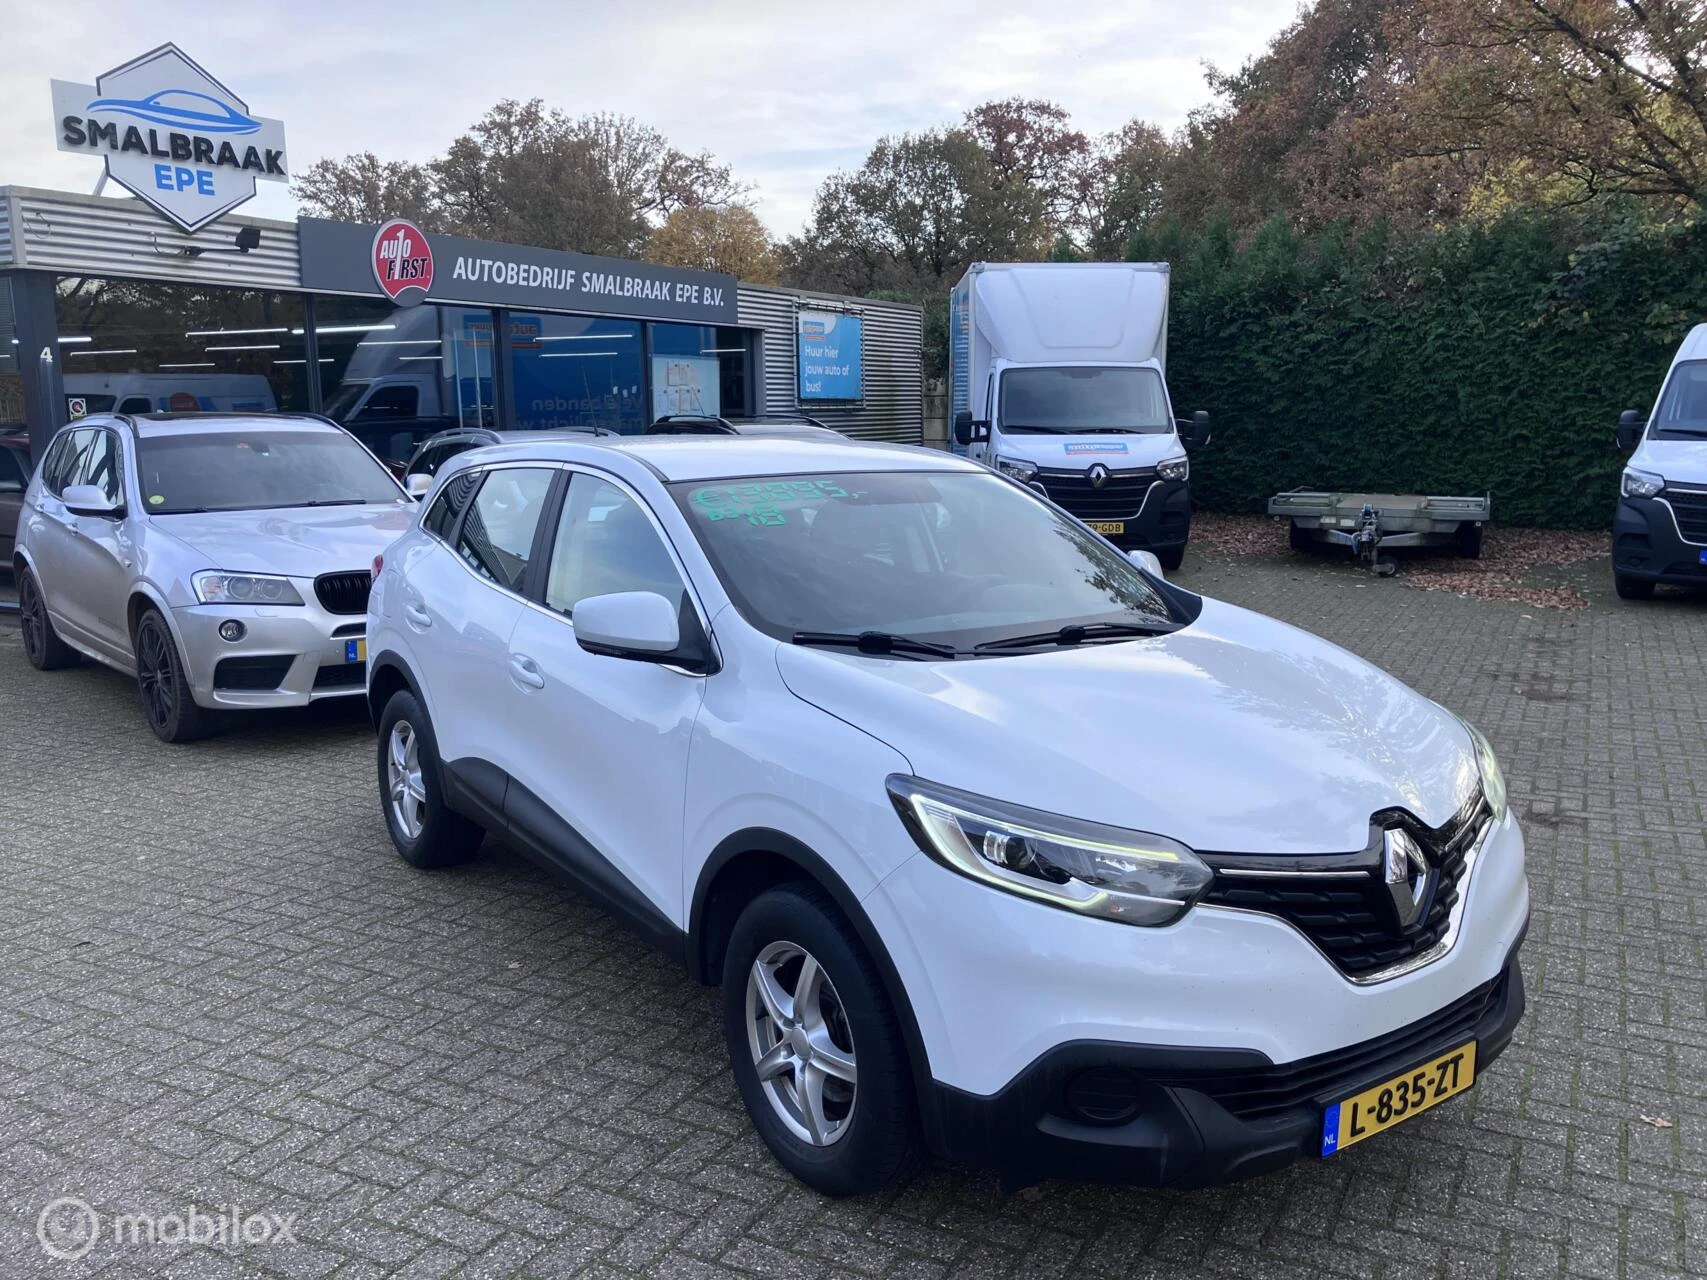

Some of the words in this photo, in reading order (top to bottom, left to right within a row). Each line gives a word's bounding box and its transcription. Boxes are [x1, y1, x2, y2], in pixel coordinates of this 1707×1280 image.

[62, 116, 286, 176] SMALBRAAK
[154, 164, 215, 196] EPE
[453, 256, 576, 291] AUTOBEDRIJF
[582, 271, 671, 302] SMALBRAAK
[676, 283, 699, 304] EPE
[704, 286, 724, 307] B.V.
[40, 346, 53, 363] 4
[804, 345, 823, 357] Huur
[824, 345, 838, 358] hier
[804, 361, 823, 376] jouw
[824, 366, 841, 376] auto
[842, 364, 850, 376] of
[805, 380, 821, 392] bus!
[1350, 1053, 1464, 1138] L-835-ZT
[1324, 1133, 1337, 1147] NL
